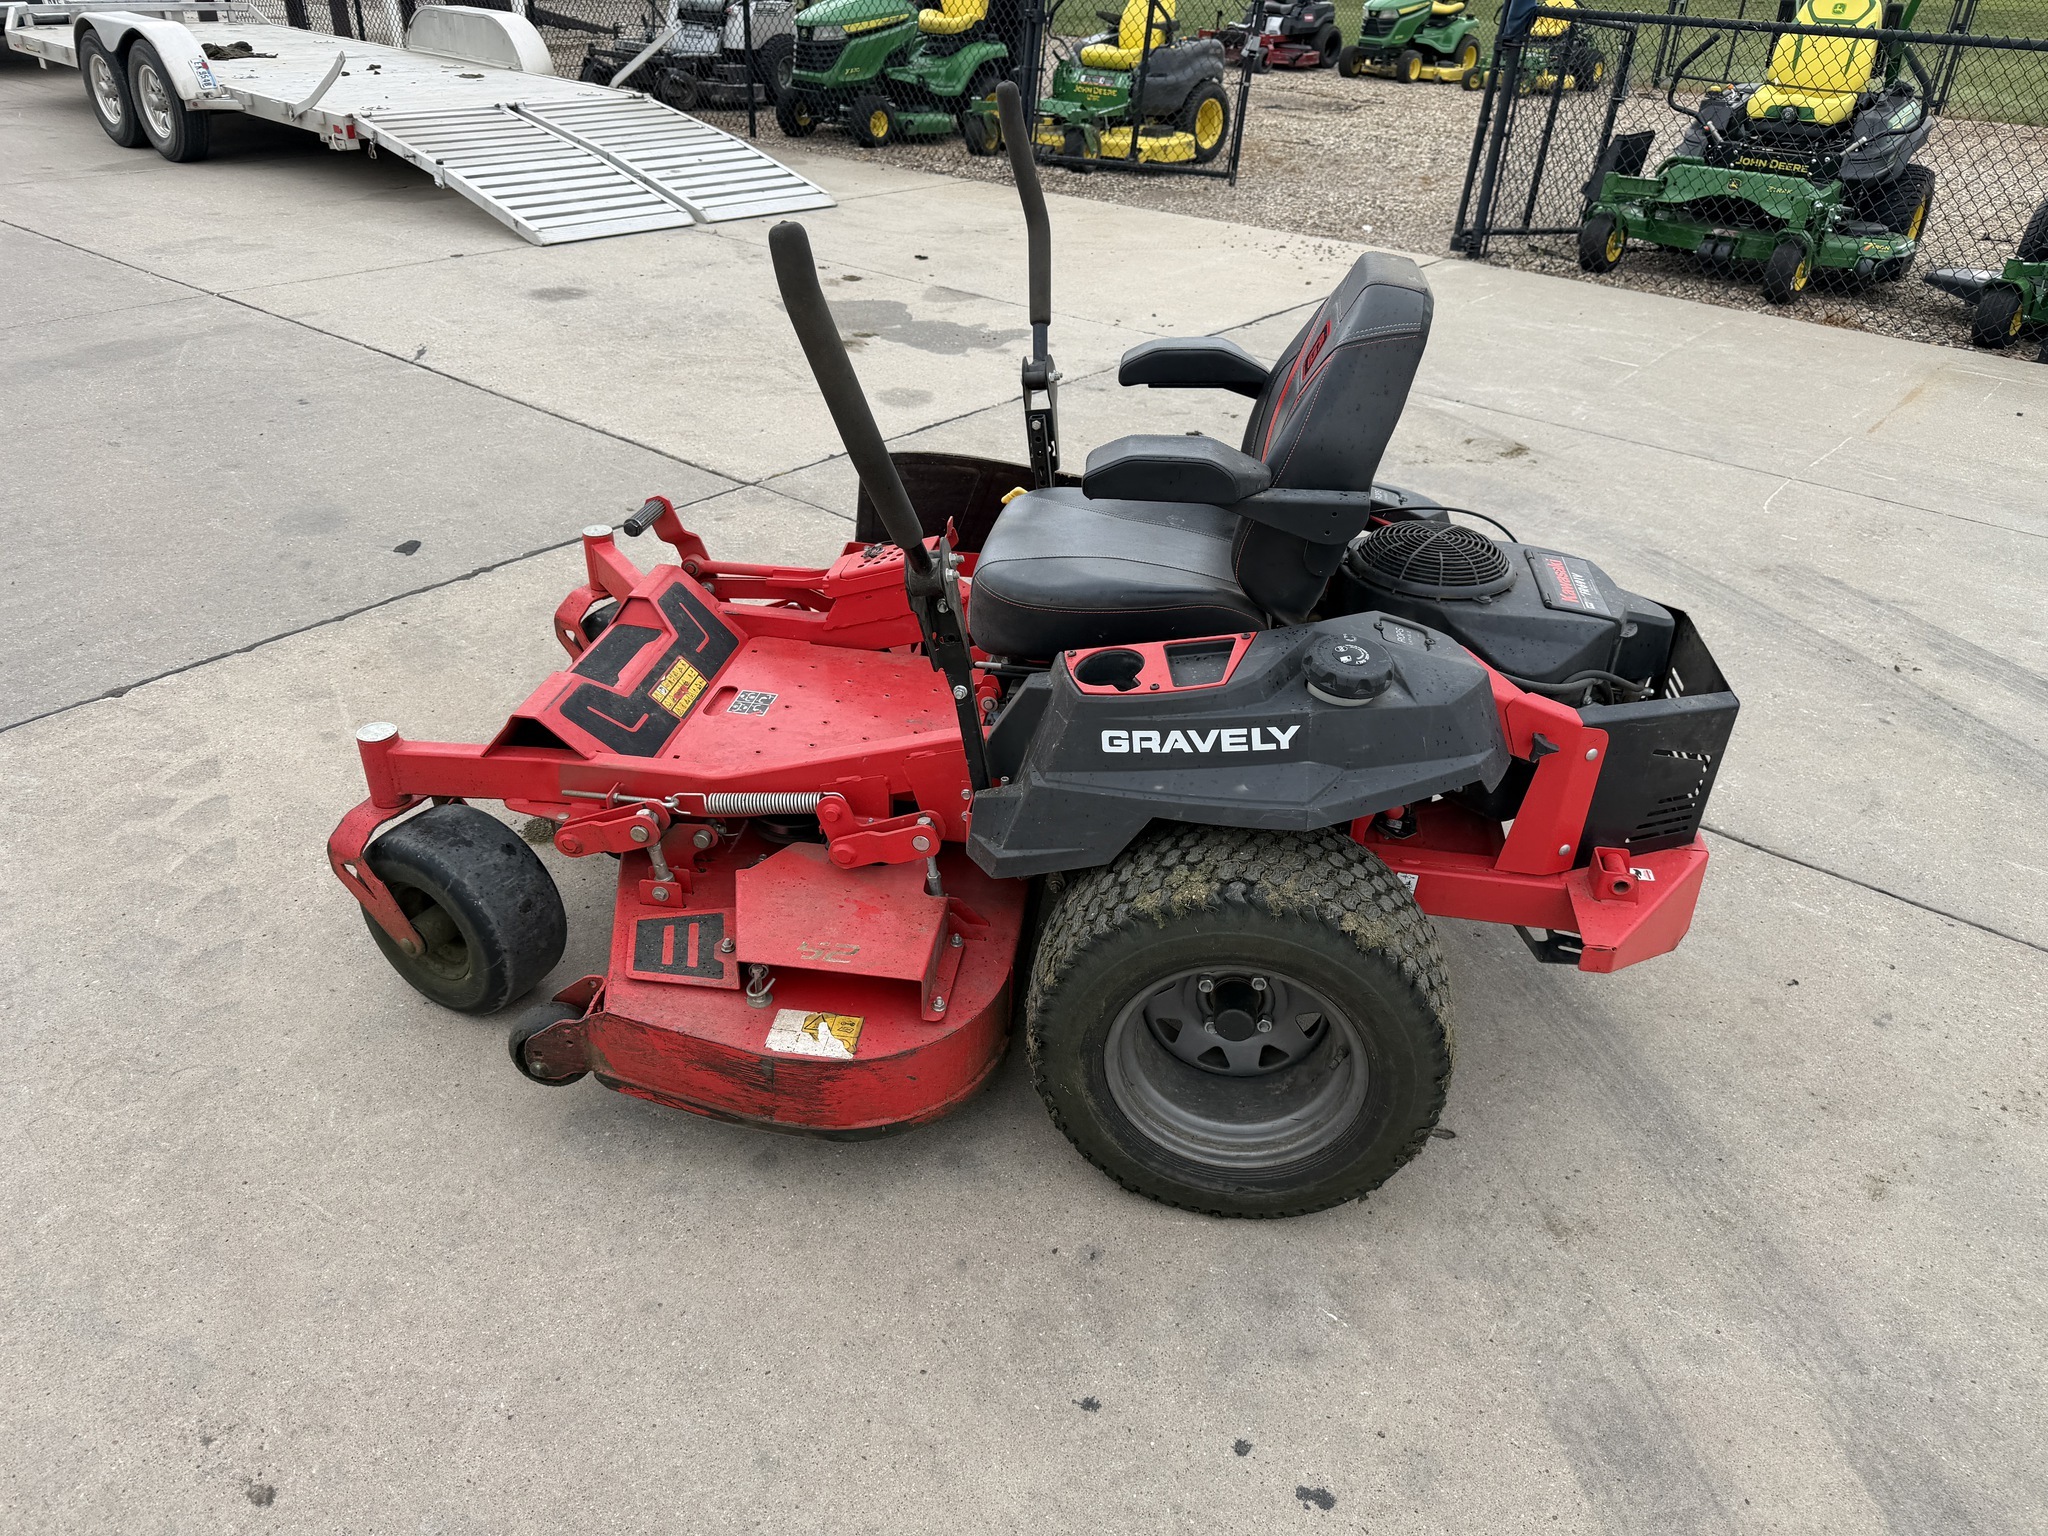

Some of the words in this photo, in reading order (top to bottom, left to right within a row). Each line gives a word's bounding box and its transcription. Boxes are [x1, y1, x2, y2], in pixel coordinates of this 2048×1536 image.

[1735, 156, 1767, 168] JOHN
[1769, 160, 1810, 173] DEERE
[1545, 558, 1580, 603] Kawasaki
[1101, 725, 1301, 753] GRAVELY
